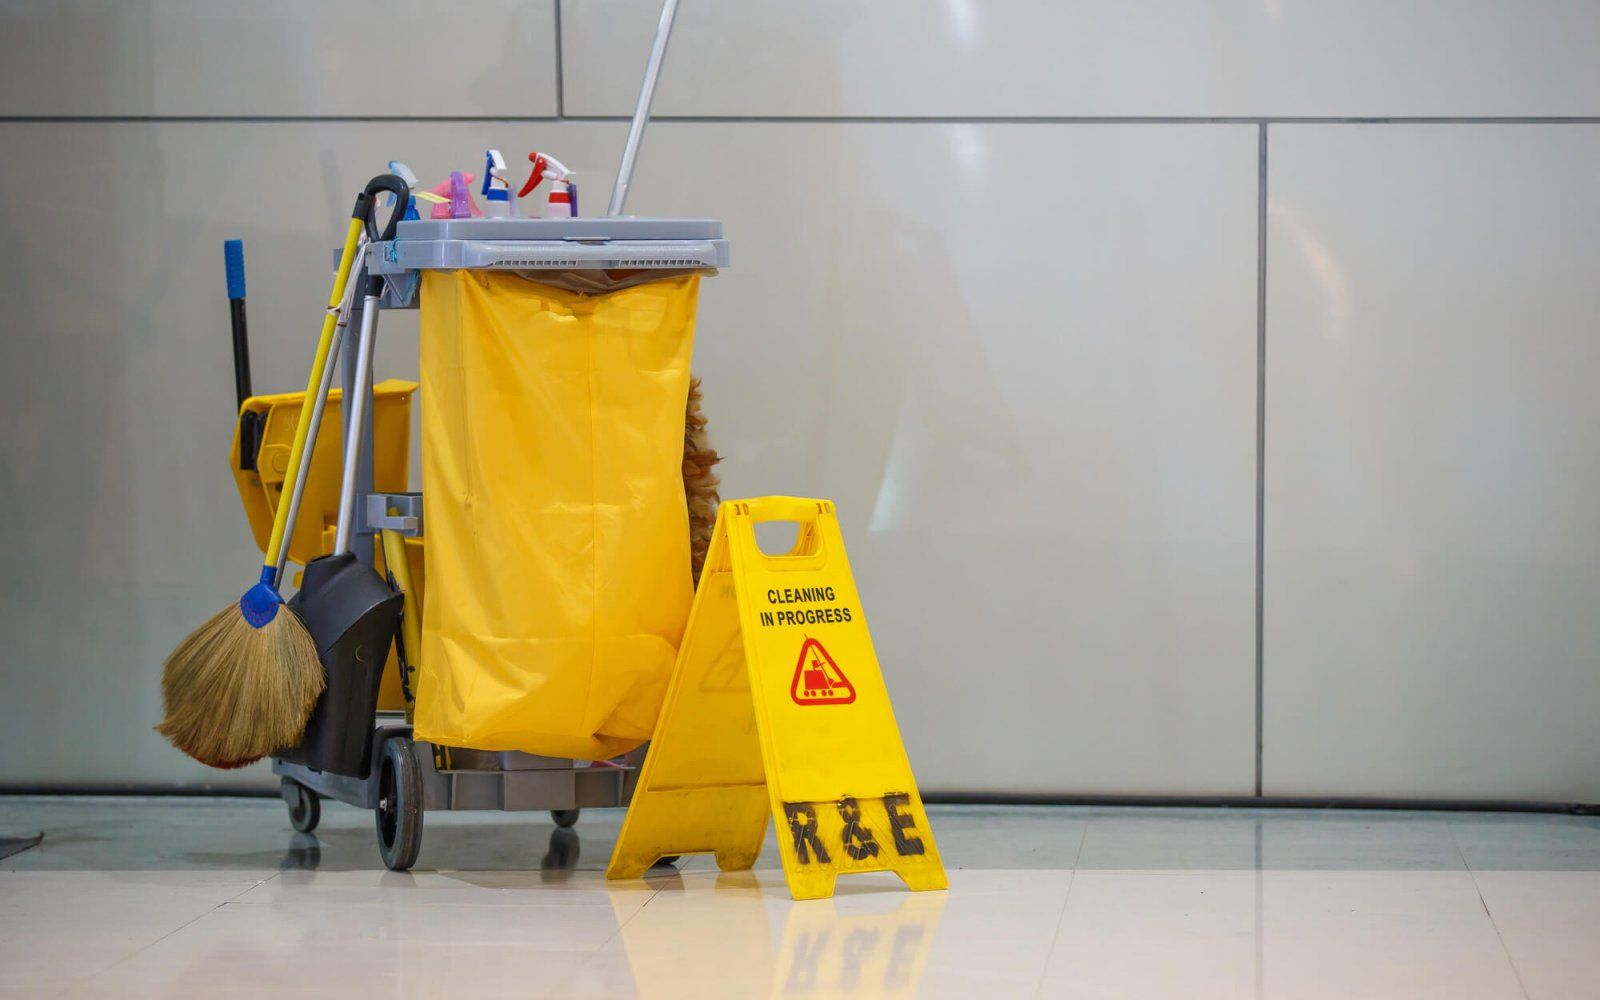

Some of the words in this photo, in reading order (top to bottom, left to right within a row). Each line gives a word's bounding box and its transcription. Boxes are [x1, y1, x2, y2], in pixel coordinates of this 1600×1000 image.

[767, 587, 835, 604] CLEANING
[760, 611, 774, 626] IN
[777, 608, 852, 625] PROGRESS
